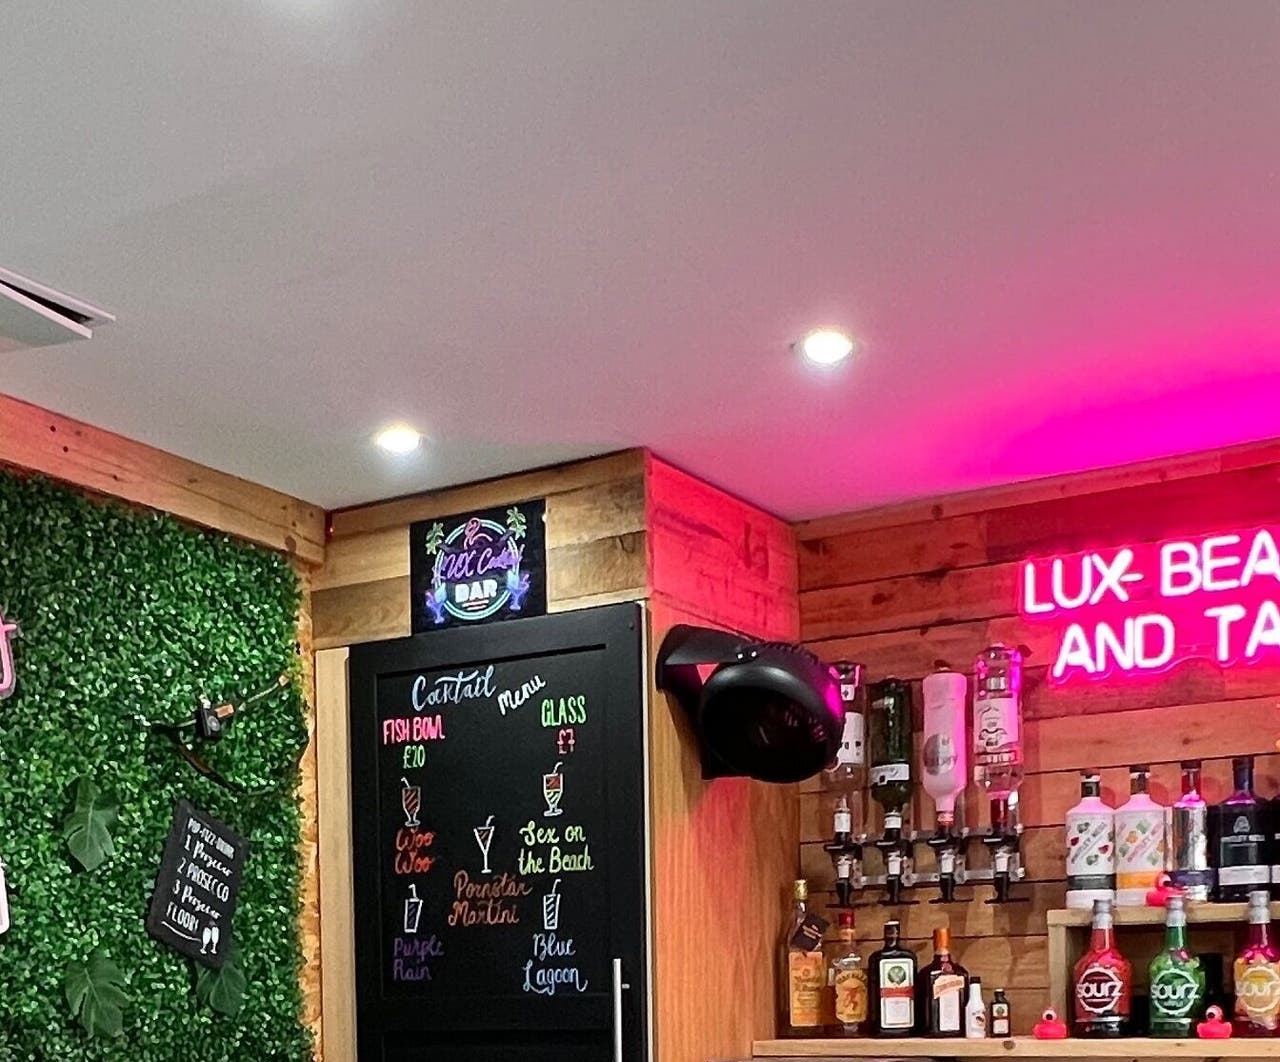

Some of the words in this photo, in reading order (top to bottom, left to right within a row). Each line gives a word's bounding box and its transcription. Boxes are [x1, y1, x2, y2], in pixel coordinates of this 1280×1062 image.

[455, 579, 498, 603] BAR
[1053, 613, 1176, 679] AND
[411, 665, 497, 711] Cocktail
[497, 675, 547, 715] Menu
[541, 696, 587, 727] GLASS
[383, 717, 410, 745] FISH
[413, 714, 446, 742] BOWL
[557, 729, 576, 754] £7
[403, 745, 426, 769] £20
[184, 834, 192, 851] 1
[395, 828, 437, 851] Woo
[519, 820, 559, 846] Sex
[565, 825, 586, 842] on
[176, 857, 187, 874] 2
[394, 851, 436, 875] Woo
[518, 849, 545, 875] the
[548, 845, 595, 873] Beach
[172, 879, 181, 895] 3
[453, 869, 533, 900] Pornstar
[448, 900, 520, 927] Martini
[393, 935, 445, 961] Purple
[532, 933, 577, 961] Blue
[393, 959, 432, 982] Rain
[523, 959, 588, 996] Lagoon
